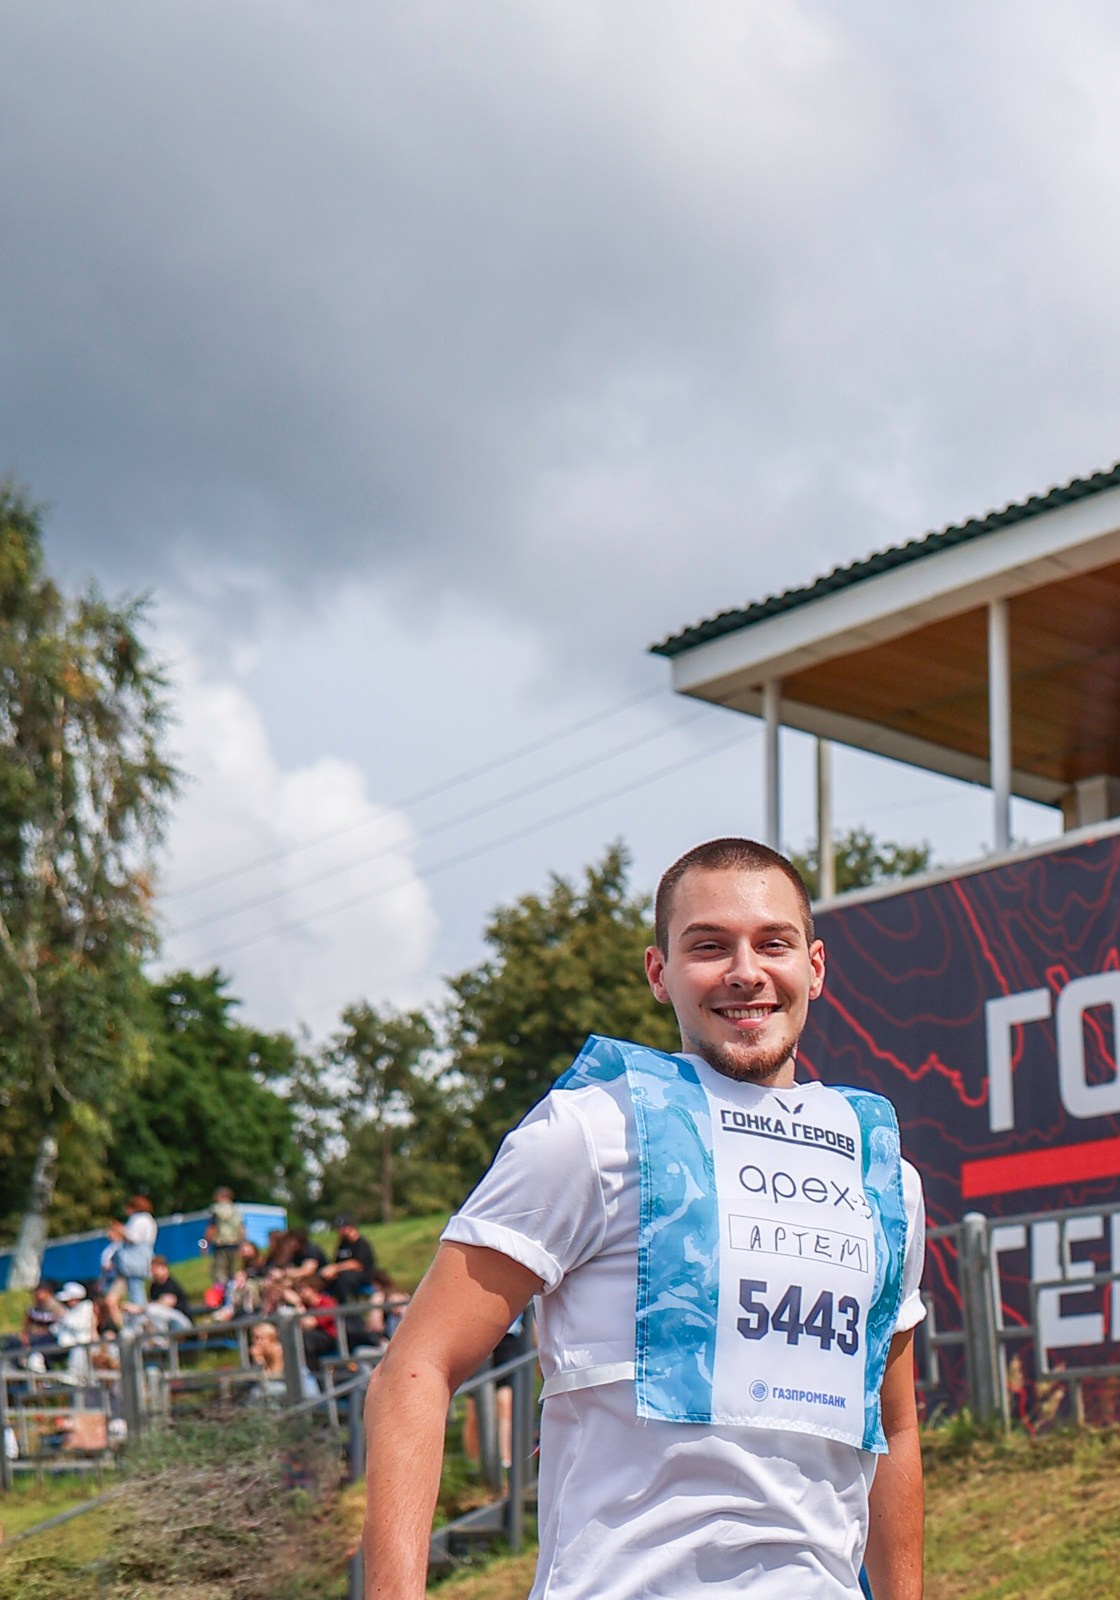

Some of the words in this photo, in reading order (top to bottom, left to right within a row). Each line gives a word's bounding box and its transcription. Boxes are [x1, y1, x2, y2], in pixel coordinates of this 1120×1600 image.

[720, 1109, 787, 1136] ГОНКА
[791, 1122, 855, 1154] ГЕРОЕВ
[739, 1165, 855, 1211] apex
[750, 1225, 863, 1271] АРТЕМ
[737, 1278, 860, 1356] 5443
[772, 1387, 847, 1409] ГАЗПРОМБАНК
